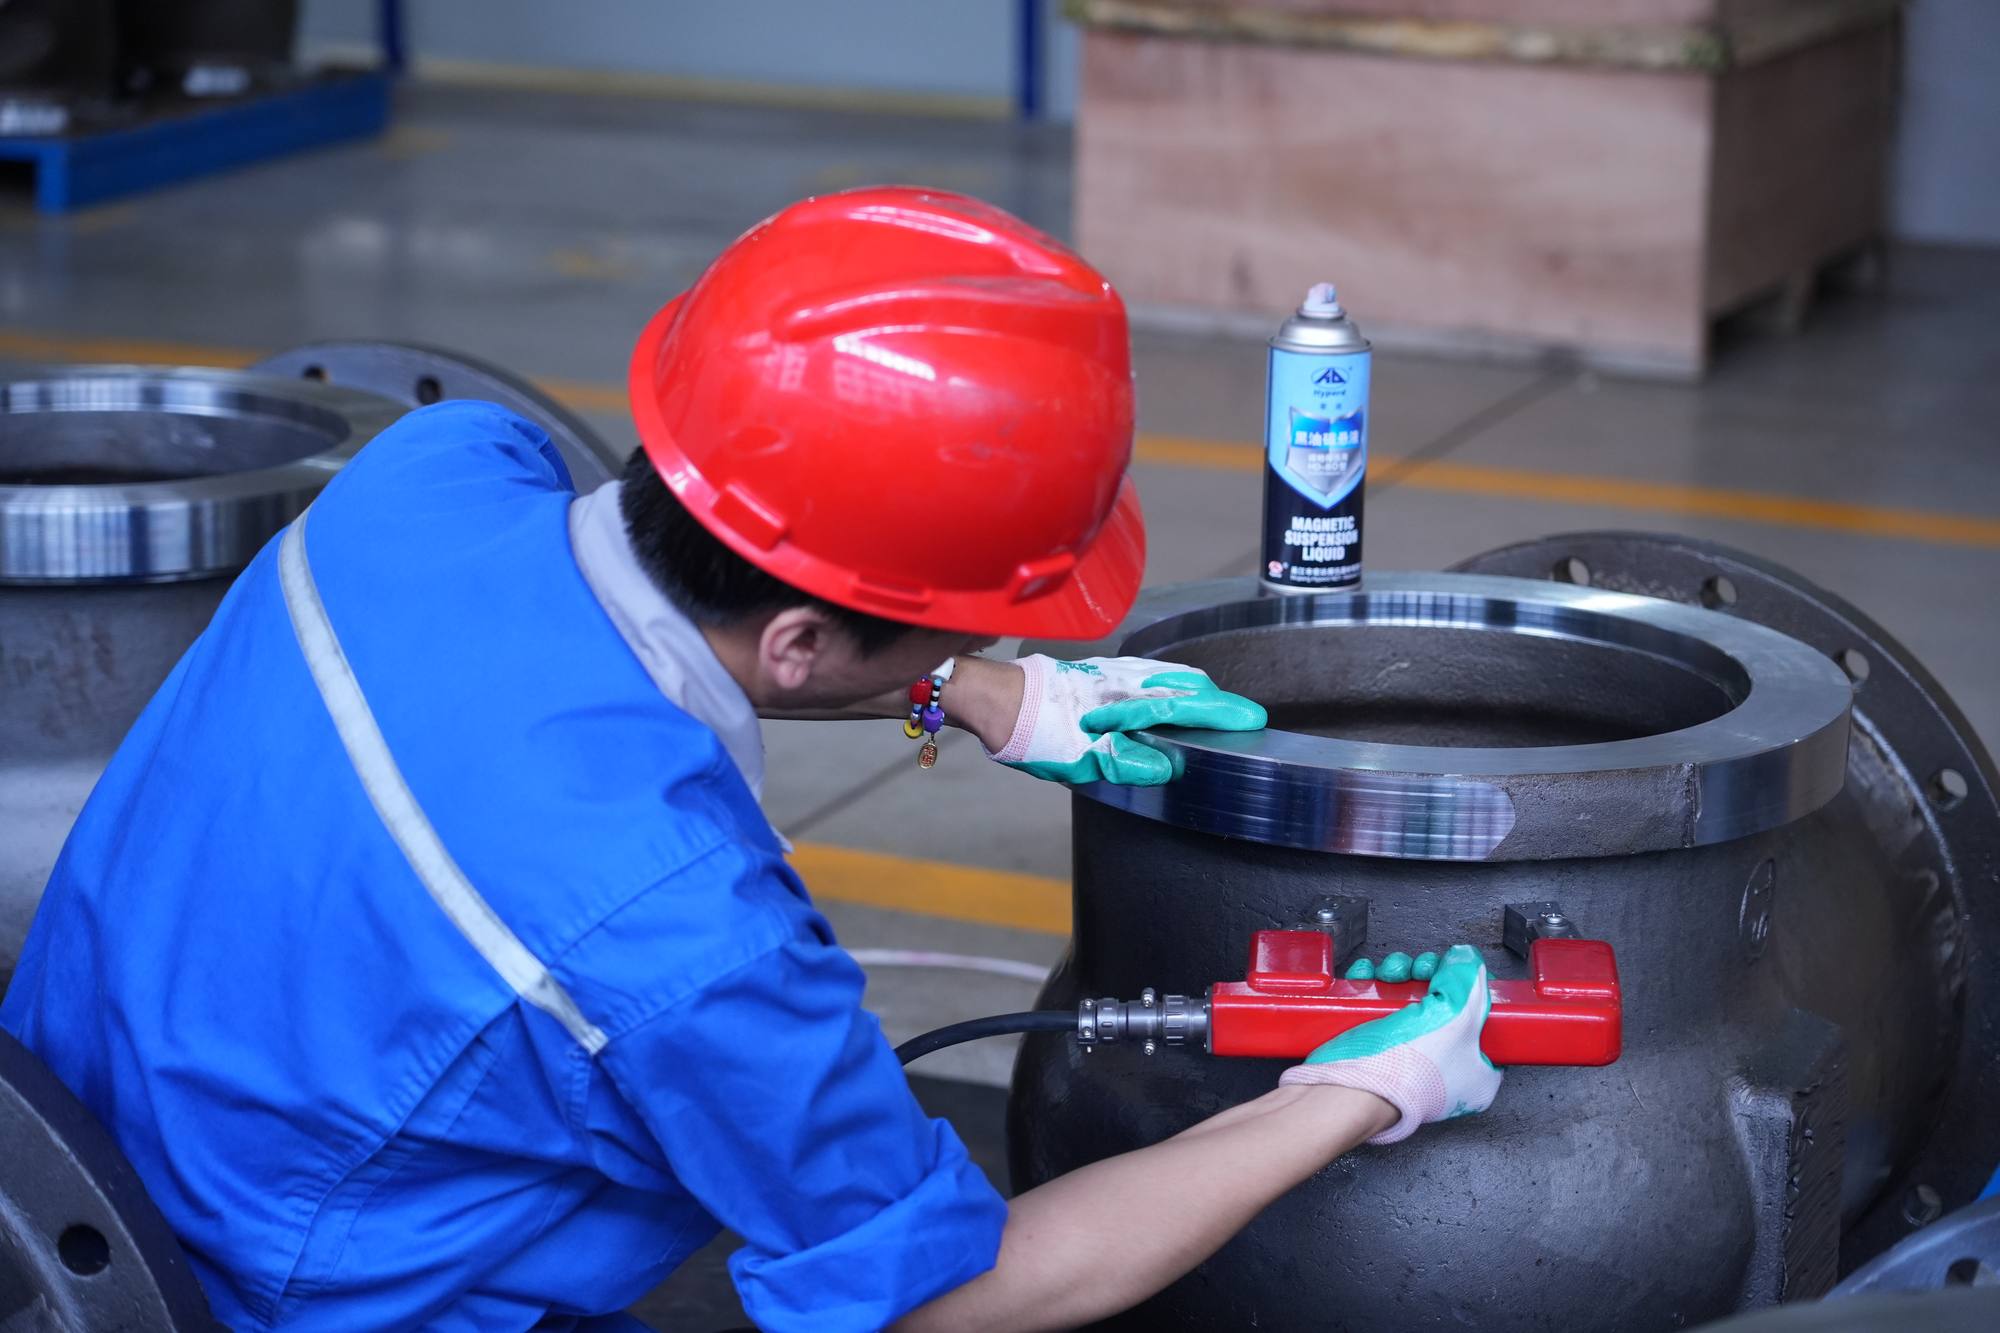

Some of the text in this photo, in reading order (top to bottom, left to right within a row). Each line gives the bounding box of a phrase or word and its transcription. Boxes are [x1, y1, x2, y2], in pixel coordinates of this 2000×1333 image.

[1291, 516, 1355, 532] MAGNETIC
[1284, 529, 1359, 546] SUSPENSION
[1302, 546, 1345, 562] LIQUID
